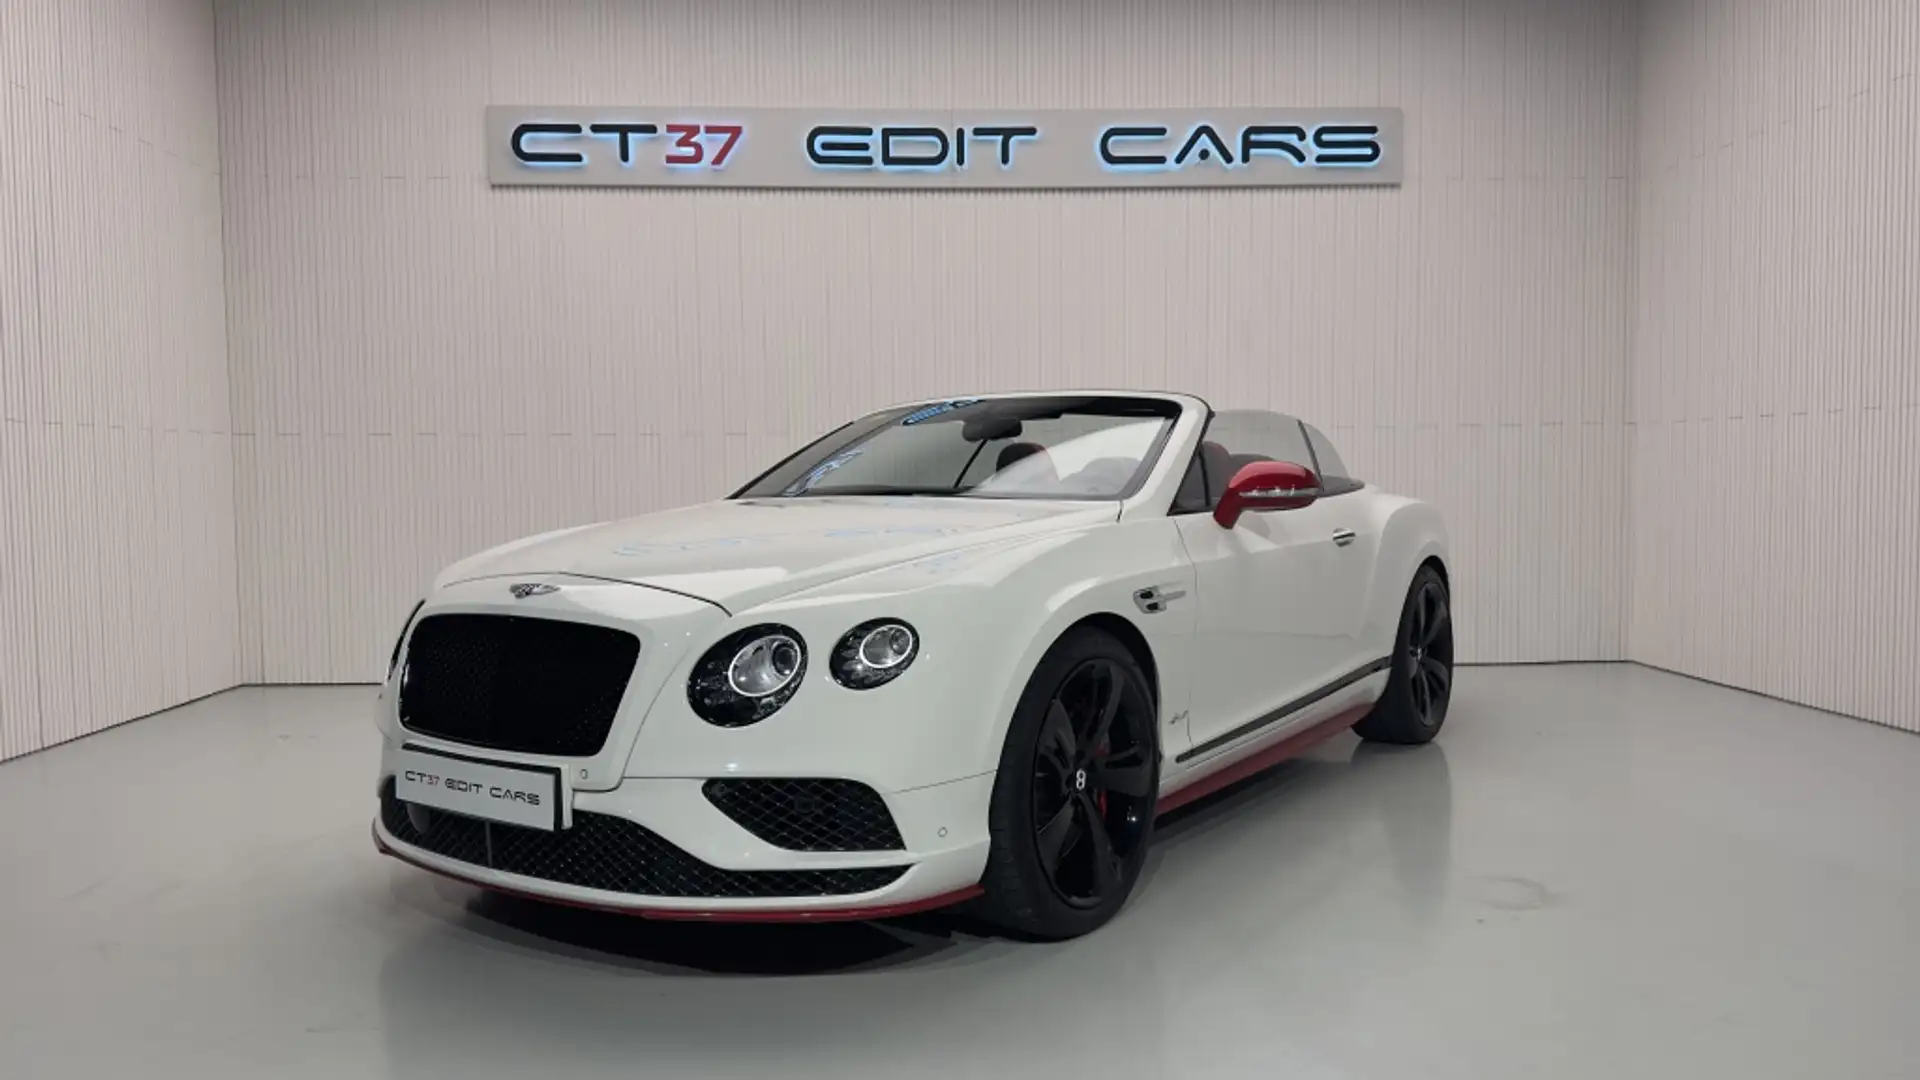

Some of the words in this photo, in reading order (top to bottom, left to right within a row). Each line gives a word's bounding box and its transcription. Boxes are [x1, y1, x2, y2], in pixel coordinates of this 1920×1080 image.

[511, 123, 742, 165] CT37
[806, 125, 1037, 166] EDIT
[1100, 125, 1381, 165] CARS
[405, 770, 440, 786] CT37
[445, 777, 483, 795] EDIT
[489, 786, 541, 806] CARS
